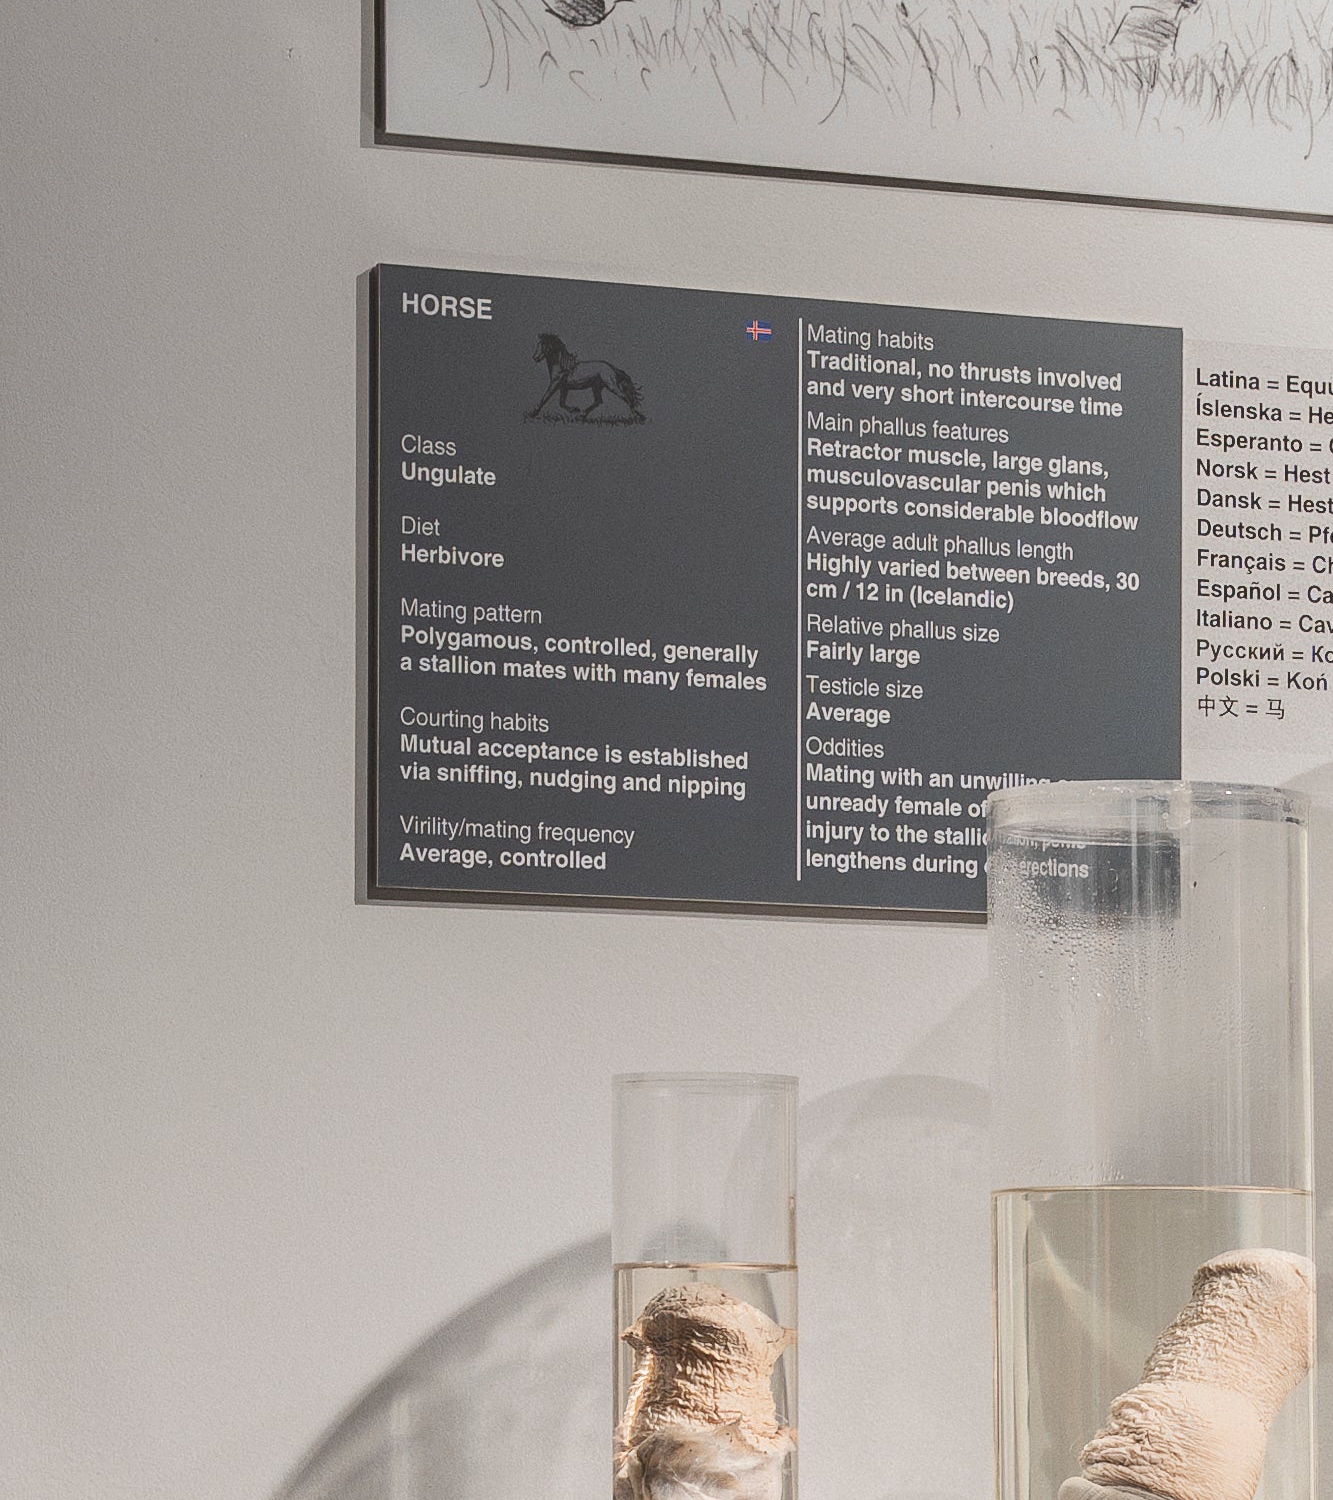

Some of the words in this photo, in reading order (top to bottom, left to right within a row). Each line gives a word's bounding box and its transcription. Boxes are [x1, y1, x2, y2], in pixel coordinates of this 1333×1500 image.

[401, 292, 493, 320] HORSE
[807, 322, 871, 350] Mating
[877, 327, 934, 350] habits
[807, 348, 922, 379] Traditional,
[928, 362, 954, 378] no
[959, 360, 1032, 384] thrusts
[1037, 365, 1122, 391] involved
[1196, 366, 1260, 390] Latina
[1266, 379, 1280, 389] =
[806, 377, 845, 396] and
[851, 382, 895, 404] very
[900, 382, 955, 404] short
[960, 386, 1075, 413] intercourse
[1079, 395, 1123, 417] time
[1196, 391, 1283, 421] Íslenska
[1288, 410, 1302, 420] =
[806, 409, 853, 432] Main
[859, 414, 927, 437] phallus
[932, 418, 1010, 443] features
[1196, 426, 1303, 452] Esperanto
[1309, 441, 1323, 451] =
[401, 432, 457, 456] Class
[806, 436, 903, 461] Retractor
[908, 447, 987, 470] muscle,
[993, 449, 1043, 473] large
[1048, 454, 1109, 478] glans,
[401, 459, 497, 486] Ungulate
[806, 467, 982, 493] musculovascular
[986, 477, 1042, 497] penis
[1046, 480, 1106, 502] which
[1196, 457, 1259, 479] Norsk
[1264, 468, 1277, 478] =
[1284, 462, 1331, 484] Hest
[806, 493, 899, 516] supports
[904, 499, 1035, 523] considerable
[1040, 505, 1139, 530] bloodflow
[1197, 486, 1262, 509] Dansk
[1268, 498, 1281, 508] =
[401, 514, 440, 536] Diet
[1197, 517, 1282, 541] Deutsch
[1289, 530, 1302, 540] =
[401, 542, 505, 567] Herbivore
[806, 524, 887, 552] Average
[892, 531, 939, 551] adult
[943, 533, 1011, 557] phallus
[1016, 537, 1074, 564] length
[806, 550, 872, 578] Highly
[877, 557, 940, 578] varied
[946, 559, 1031, 583] between
[1036, 565, 1111, 592] breeds,
[1115, 570, 1140, 590] 30
[1197, 547, 1286, 574] Français
[1292, 560, 1306, 570] =
[805, 581, 837, 598] cm
[842, 579, 851, 599] /
[855, 580, 879, 601] 12
[885, 582, 904, 602] in
[909, 583, 1014, 613] (Icelandic)
[1197, 577, 1281, 603] Español
[1287, 590, 1301, 600] =
[401, 596, 467, 624] Mating
[473, 603, 542, 624] pattern
[1196, 607, 1273, 630] Italiano
[1279, 619, 1292, 629] =
[805, 612, 884, 636] Relative
[889, 617, 957, 641] phallus
[962, 622, 1000, 643] size
[401, 623, 539, 654] Polygamous,
[544, 635, 657, 661] controlled,
[663, 643, 759, 668] generally
[805, 638, 864, 665] Fairly
[869, 642, 921, 668] large
[1196, 637, 1285, 662] Русский
[1291, 649, 1304, 660] =
[400, 654, 413, 670] a
[418, 653, 497, 675] stallion
[503, 659, 567, 679] mates
[572, 661, 617, 682] with
[623, 667, 681, 690] many
[685, 667, 768, 690] females
[1196, 665, 1260, 687] Polski
[1267, 676, 1280, 686] =
[1287, 670, 1328, 691] Koń
[805, 673, 880, 696] Testicle
[885, 678, 924, 699] size
[400, 705, 484, 733] Courting
[490, 710, 550, 732] habits
[805, 700, 891, 727] Average
[1197, 693, 1239, 717] 中文
[1245, 703, 1259, 713] =
[1265, 697, 1285, 720] 马
[400, 732, 471, 755] Mutual
[477, 740, 599, 763] acceptance
[605, 743, 623, 763] is
[628, 746, 749, 769] established
[805, 734, 885, 758] Oddities
[399, 760, 431, 780] via
[436, 762, 523, 789] sniffing,
[529, 767, 617, 794] nudging
[622, 772, 661, 791] and
[668, 773, 746, 801] nipping
[805, 761, 875, 788] Mating
[880, 766, 923, 786] with
[928, 771, 954, 788] an
[804, 793, 889, 817] unready
[894, 794, 963, 816] female
[399, 813, 532, 844] Virility/mating
[537, 820, 636, 848] frequency
[804, 818, 865, 845] injury
[869, 822, 891, 841] to
[895, 823, 929, 843] the
[399, 841, 494, 868] Average,
[499, 848, 607, 869] controlled
[804, 847, 907, 873] lengthens
[912, 852, 978, 878] during
